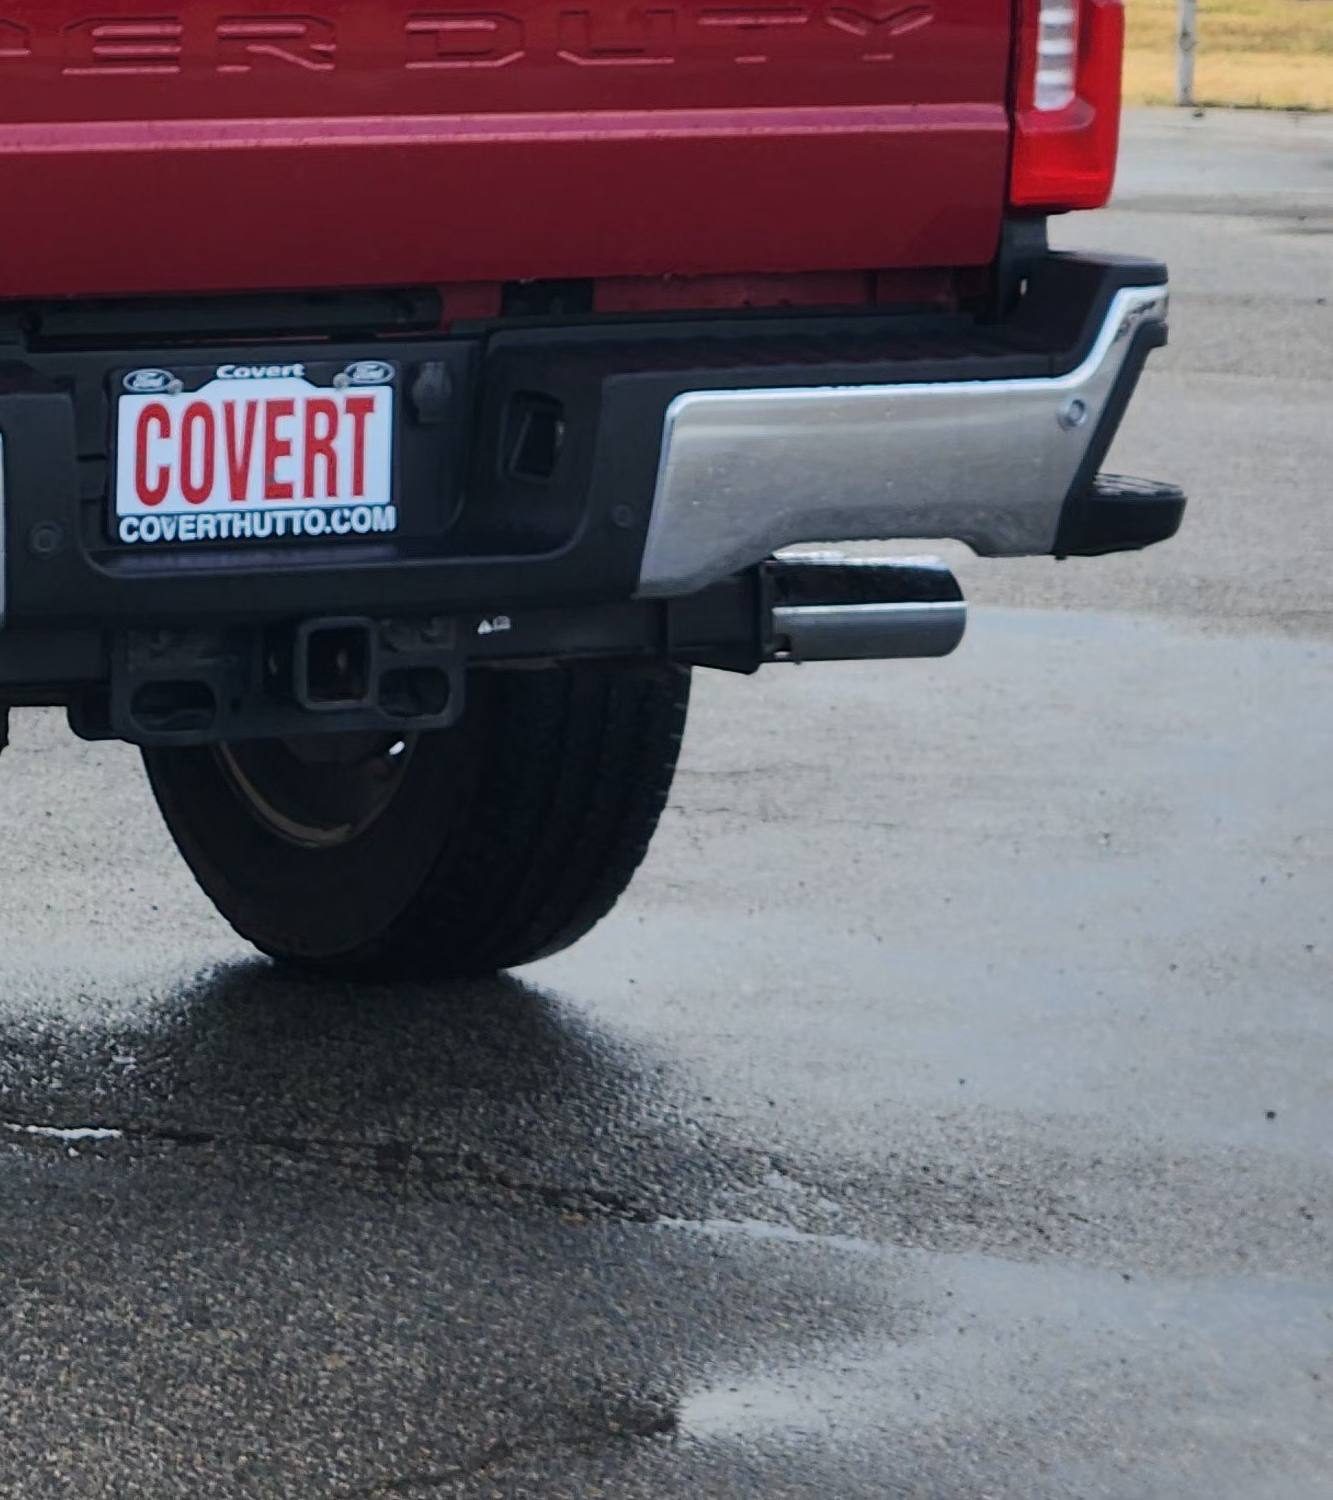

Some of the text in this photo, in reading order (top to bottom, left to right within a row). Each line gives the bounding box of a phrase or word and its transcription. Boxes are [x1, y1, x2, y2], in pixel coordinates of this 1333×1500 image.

[404, 4, 934, 69] DUTY
[216, 363, 305, 379] Covert
[136, 397, 375, 506] COVERT
[119, 506, 397, 543] COVERTHUTTO.COM
